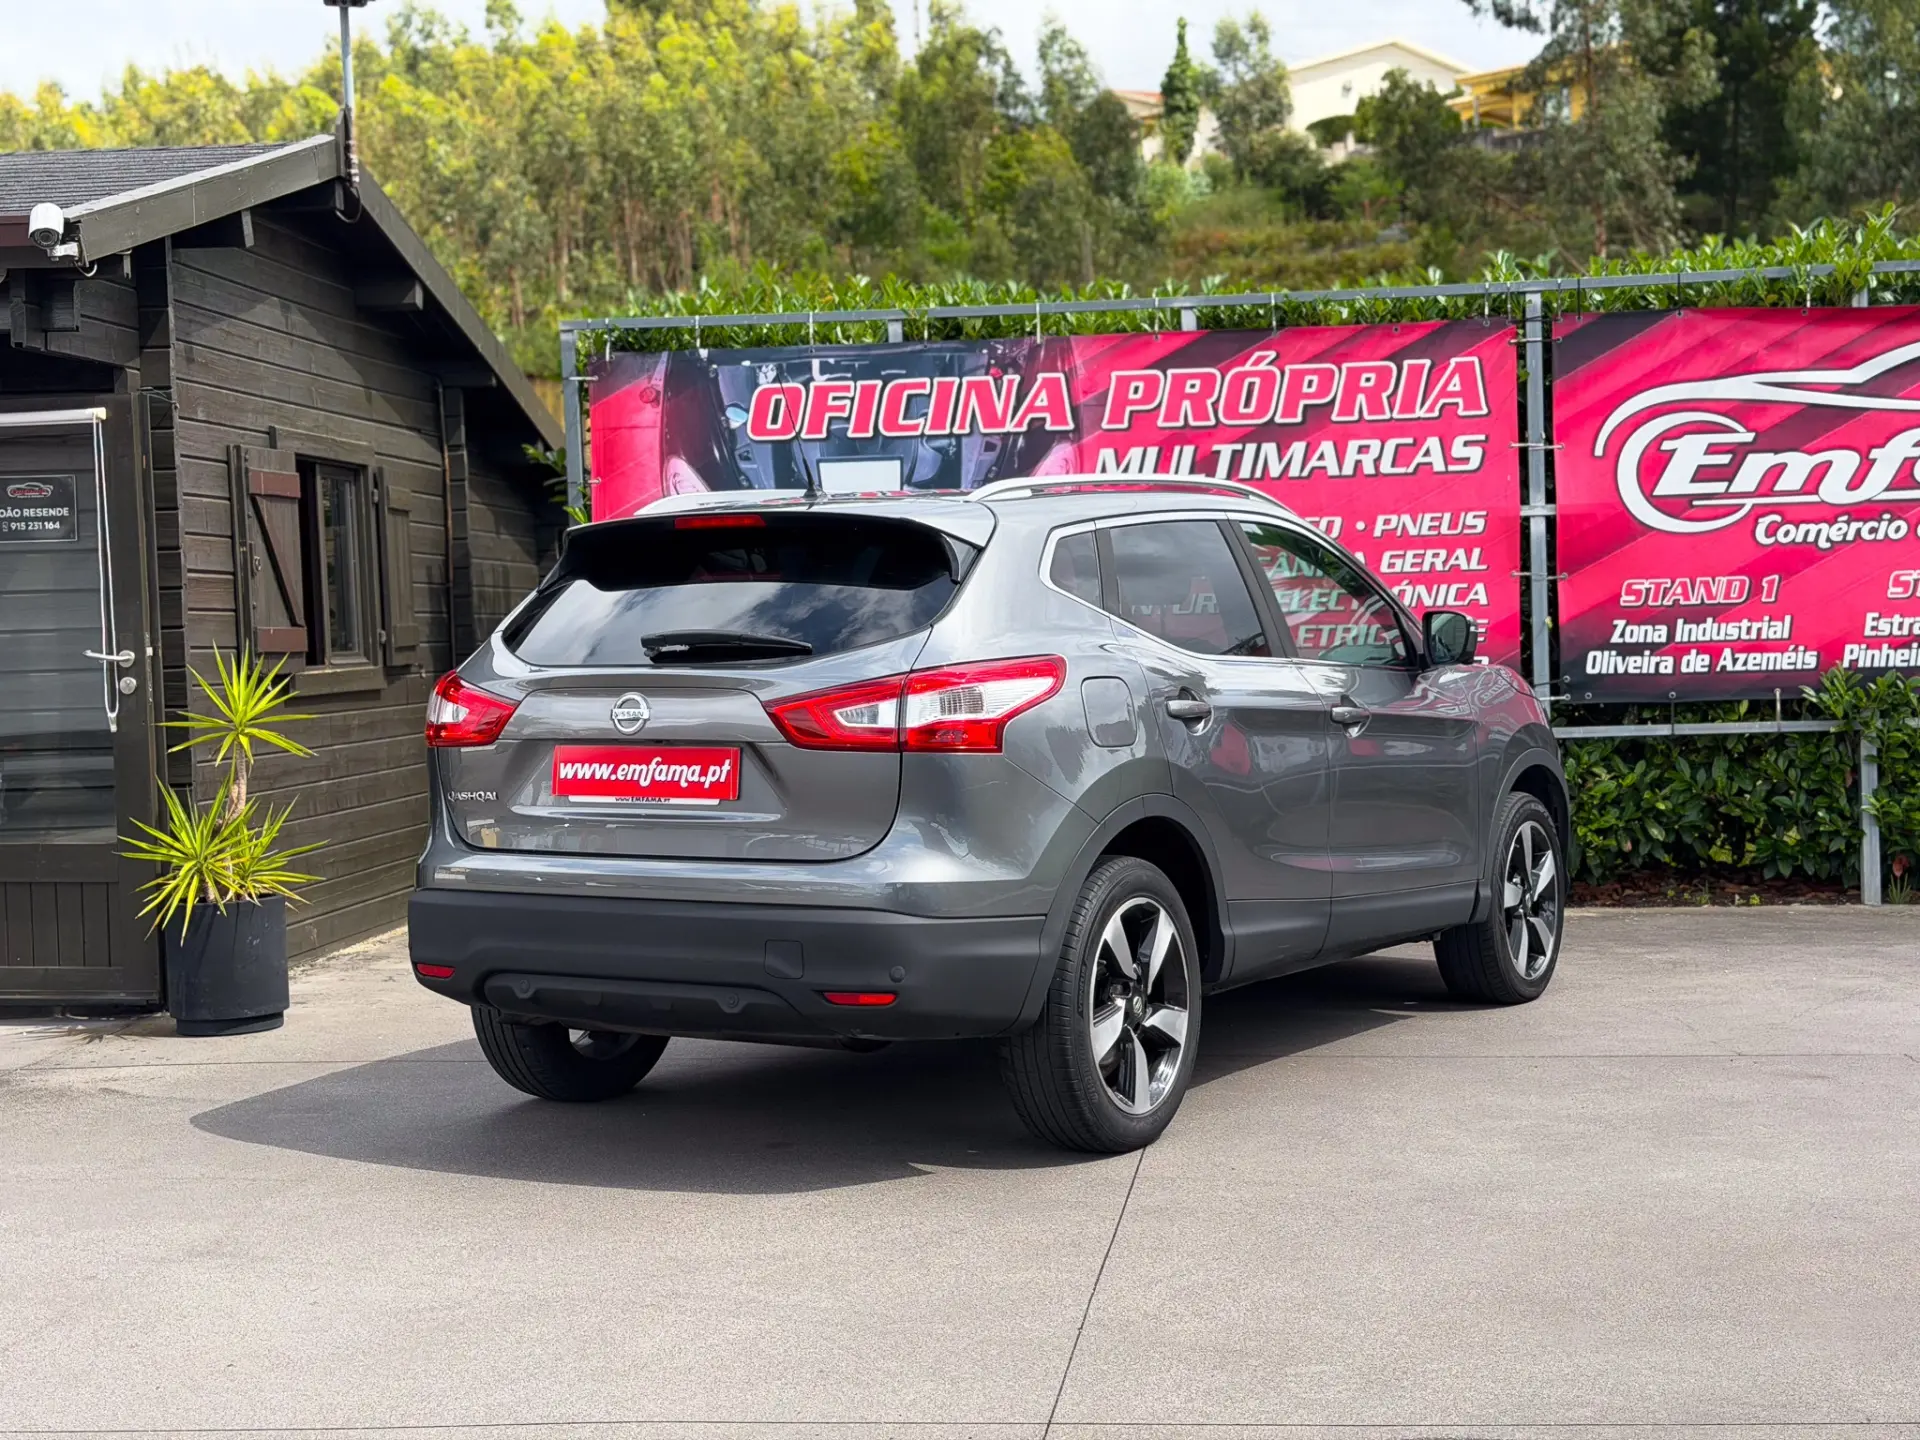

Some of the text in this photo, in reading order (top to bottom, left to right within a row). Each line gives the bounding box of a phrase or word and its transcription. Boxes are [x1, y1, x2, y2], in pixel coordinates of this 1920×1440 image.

[747, 350, 1489, 441] OFICINA PRÓPRIA
[1094, 433, 1487, 480] MULTIMARCAS
[1652, 426, 1920, 505] Emf
[10, 521, 61, 531] 915 231 164
[23, 507, 70, 518] RESENDE
[1373, 511, 1489, 538] PNEUS
[1755, 512, 1909, 549] Comércio
[1380, 547, 1489, 574] GERAL
[1620, 575, 1781, 606] STAND 1
[1610, 615, 1792, 645] Zona Industrial
[1586, 645, 1818, 675] Oliveira de Azeméis
[1843, 642, 1920, 669] Pinhei
[559, 756, 731, 788] www.emfama.pt
[447, 790, 498, 802] QASHQAI
